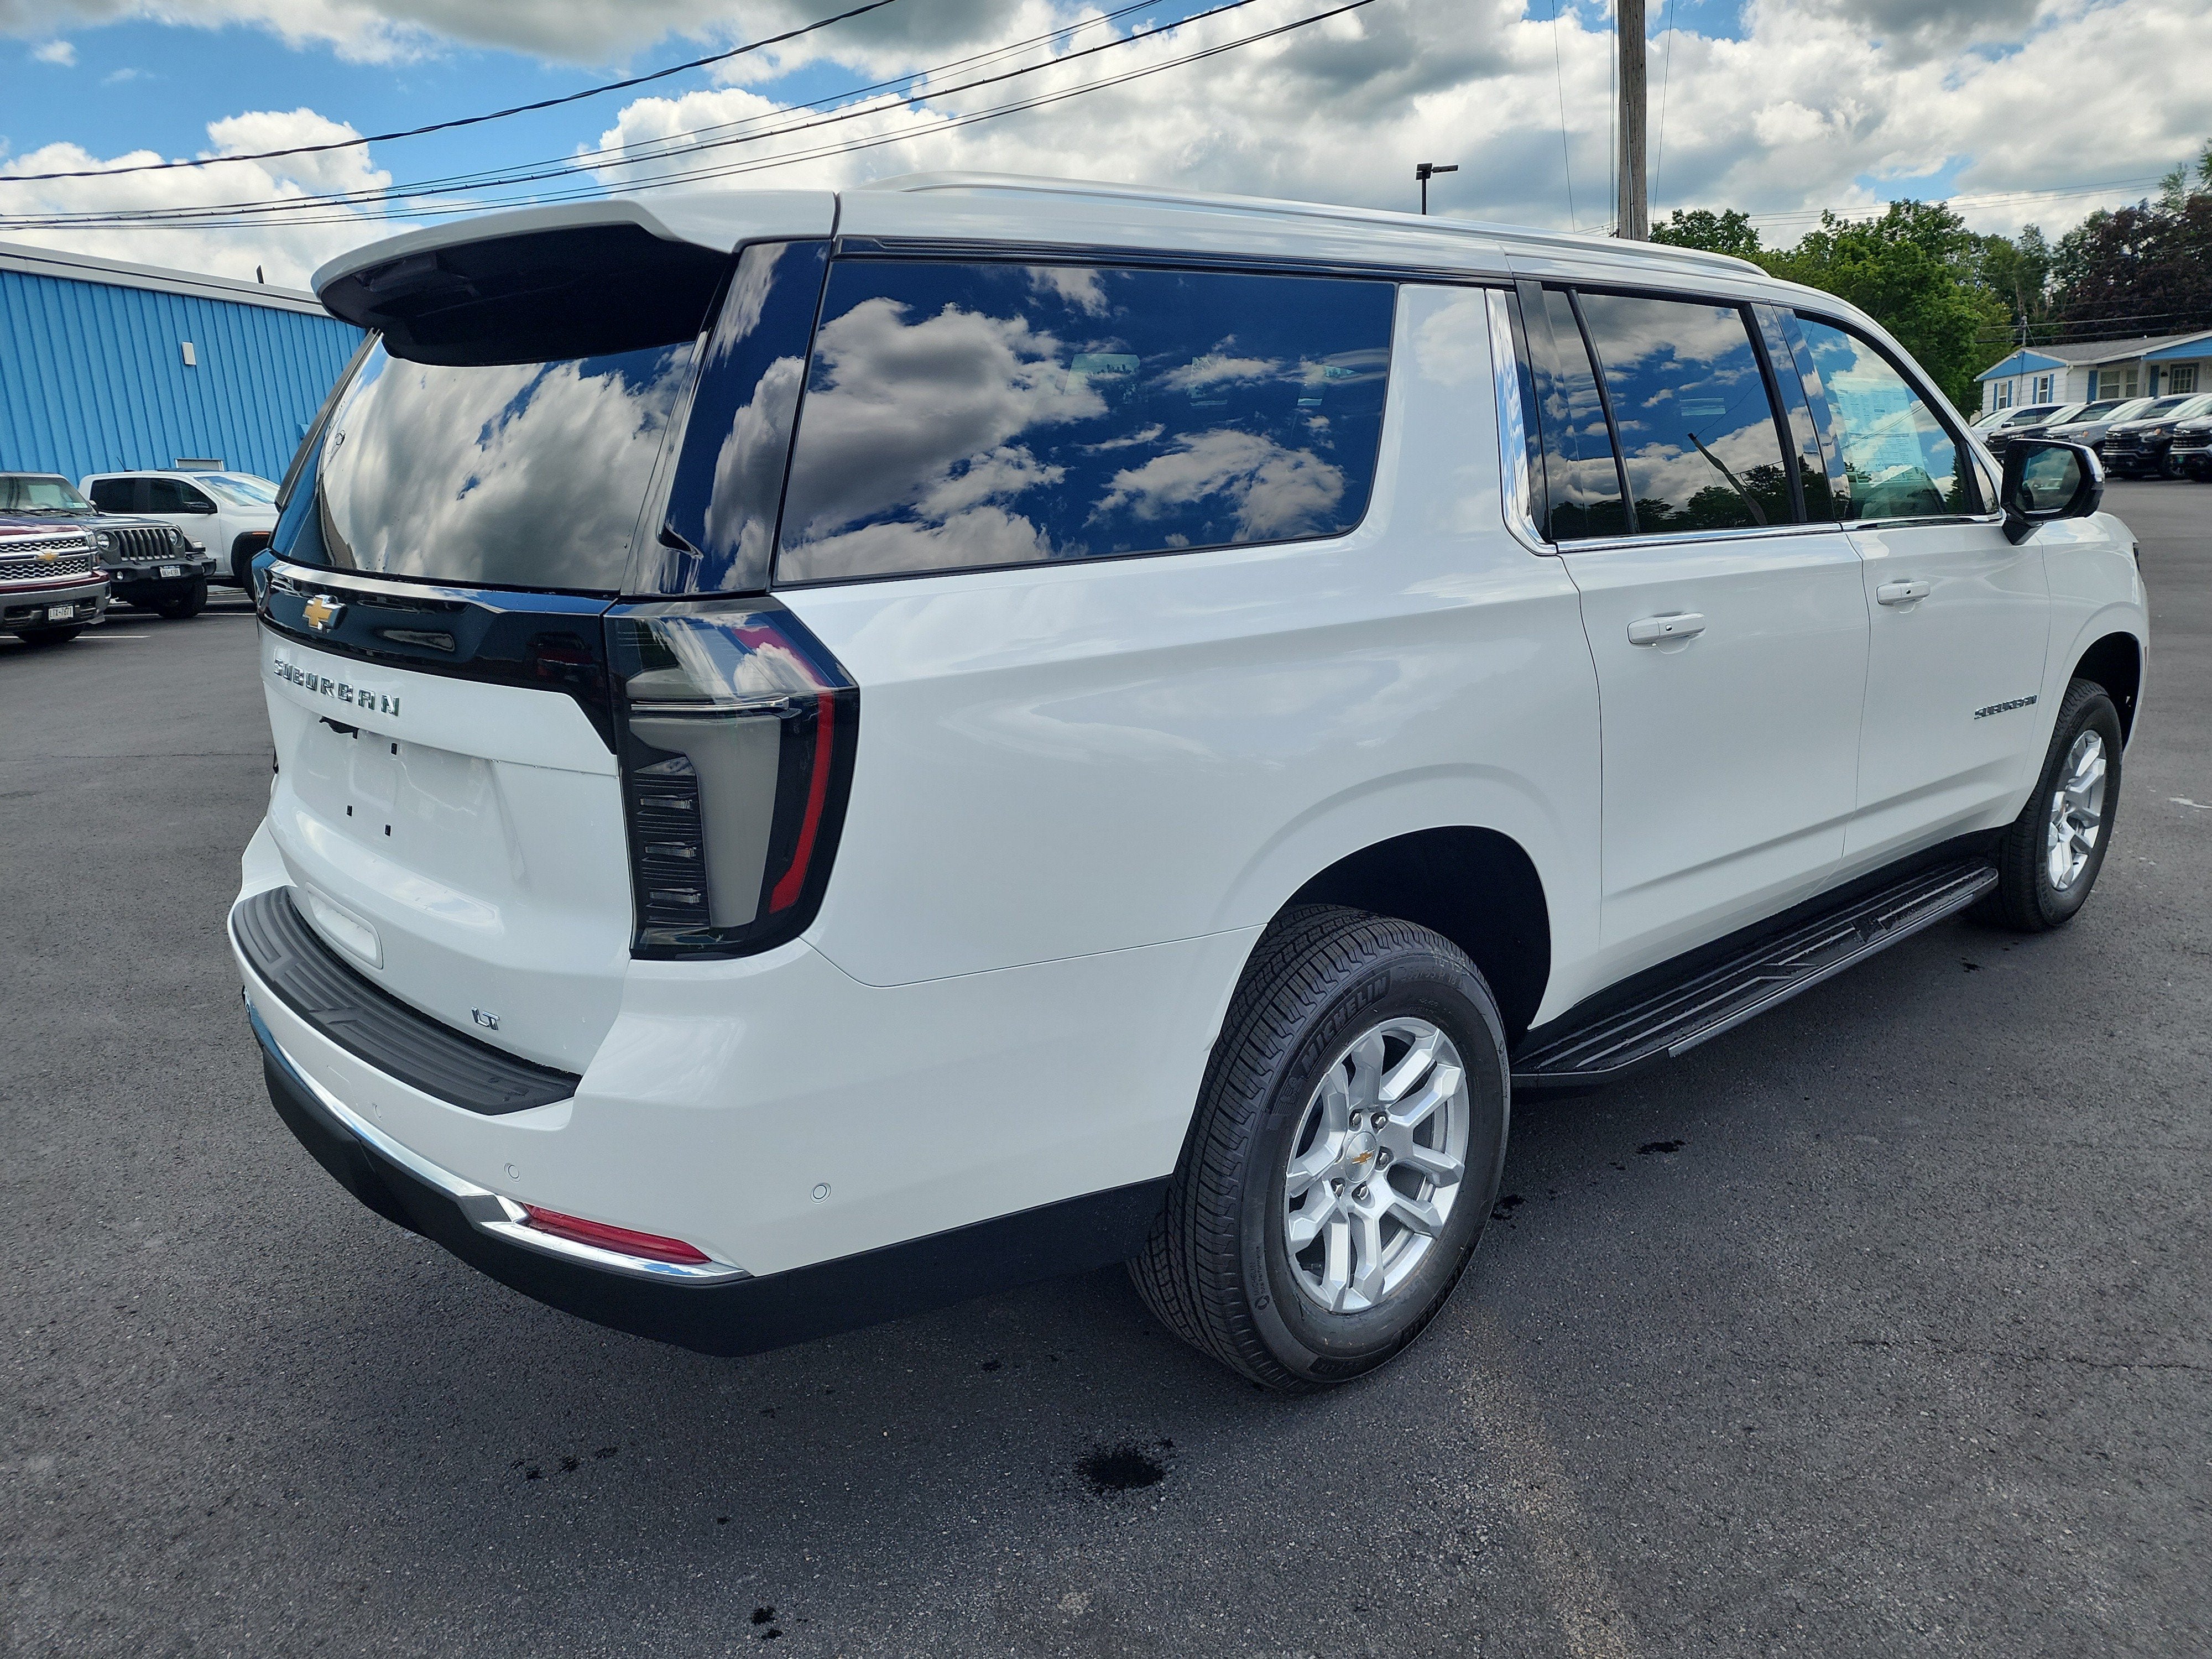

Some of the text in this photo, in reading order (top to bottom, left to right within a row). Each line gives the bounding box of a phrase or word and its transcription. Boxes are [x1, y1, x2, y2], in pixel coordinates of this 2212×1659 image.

[274, 658, 399, 717] SUBURBAN
[1974, 695, 2037, 719] SUBURBAN
[471, 1006, 500, 1030] LT
[1301, 976, 1386, 1072] MICHELIN
